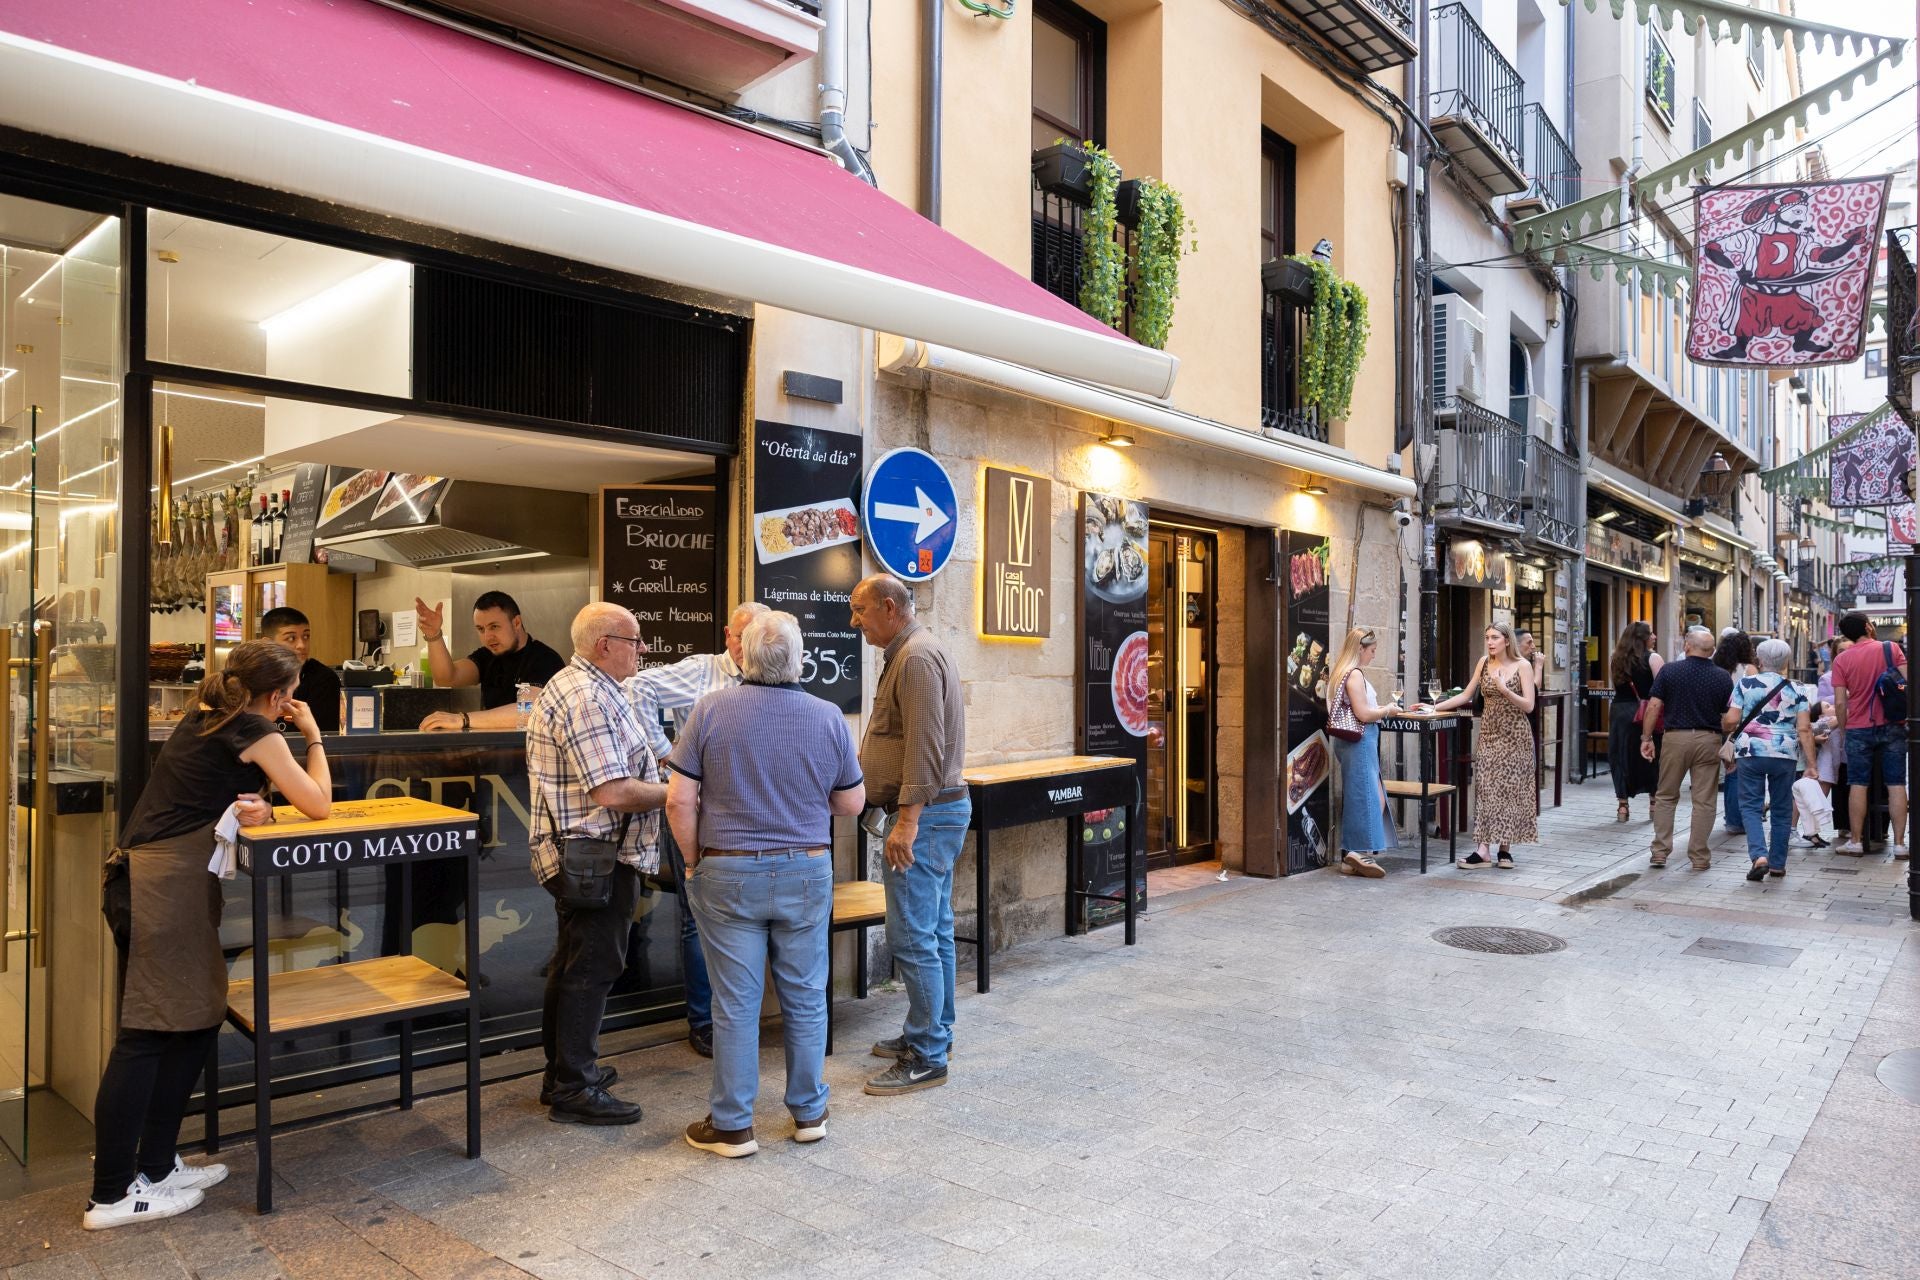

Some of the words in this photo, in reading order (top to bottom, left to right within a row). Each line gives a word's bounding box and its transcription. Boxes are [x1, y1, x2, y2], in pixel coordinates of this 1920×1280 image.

[812, 451, 827, 463] del
[648, 559, 668, 571] DE
[1005, 571, 1020, 581] casa
[764, 588, 808, 602] Lágrimas
[810, 590, 821, 602] de
[628, 608, 663, 622] ARNE
[807, 630, 826, 638] crianza
[827, 631, 840, 639] Coto
[840, 631, 857, 640] Mayor
[677, 643, 693, 654] DE
[1381, 719, 1420, 731] MAYOR
[1055, 786, 1082, 802] AMBAR
[272, 840, 352, 868] COTO
[363, 830, 462, 859] MAYOR
